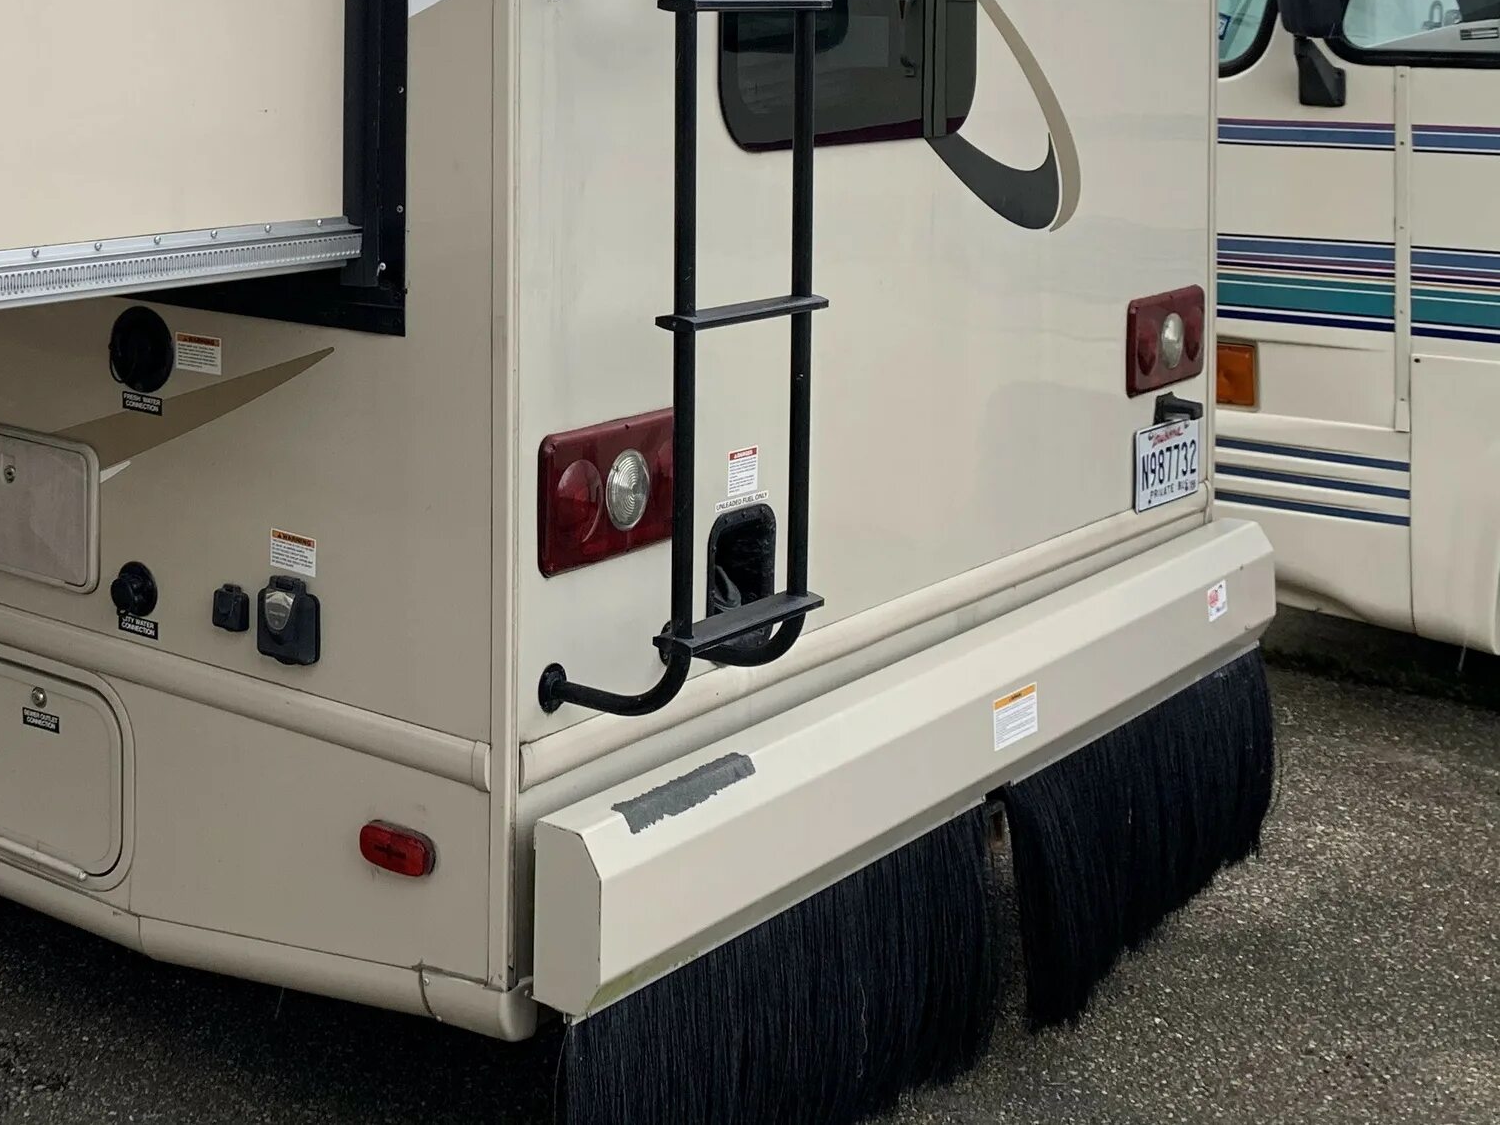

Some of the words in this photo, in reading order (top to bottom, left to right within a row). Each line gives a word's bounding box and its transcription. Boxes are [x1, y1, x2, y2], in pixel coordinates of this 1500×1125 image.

[124, 393, 141, 402] FRESH
[142, 396, 161, 406] WATER
[125, 400, 159, 412] CONNECTION
[1141, 440, 1197, 491] N987732
[1150, 483, 1174, 499] PRIVATE
[716, 498, 742, 511] UNLEADED
[742, 495, 754, 504] FUEL
[755, 492, 767, 501] ONLY
[283, 533, 312, 547] WARNING
[121, 621, 155, 635] CONNECTION
[135, 618, 155, 629] WATER
[26, 716, 56, 730] CONNECTION
